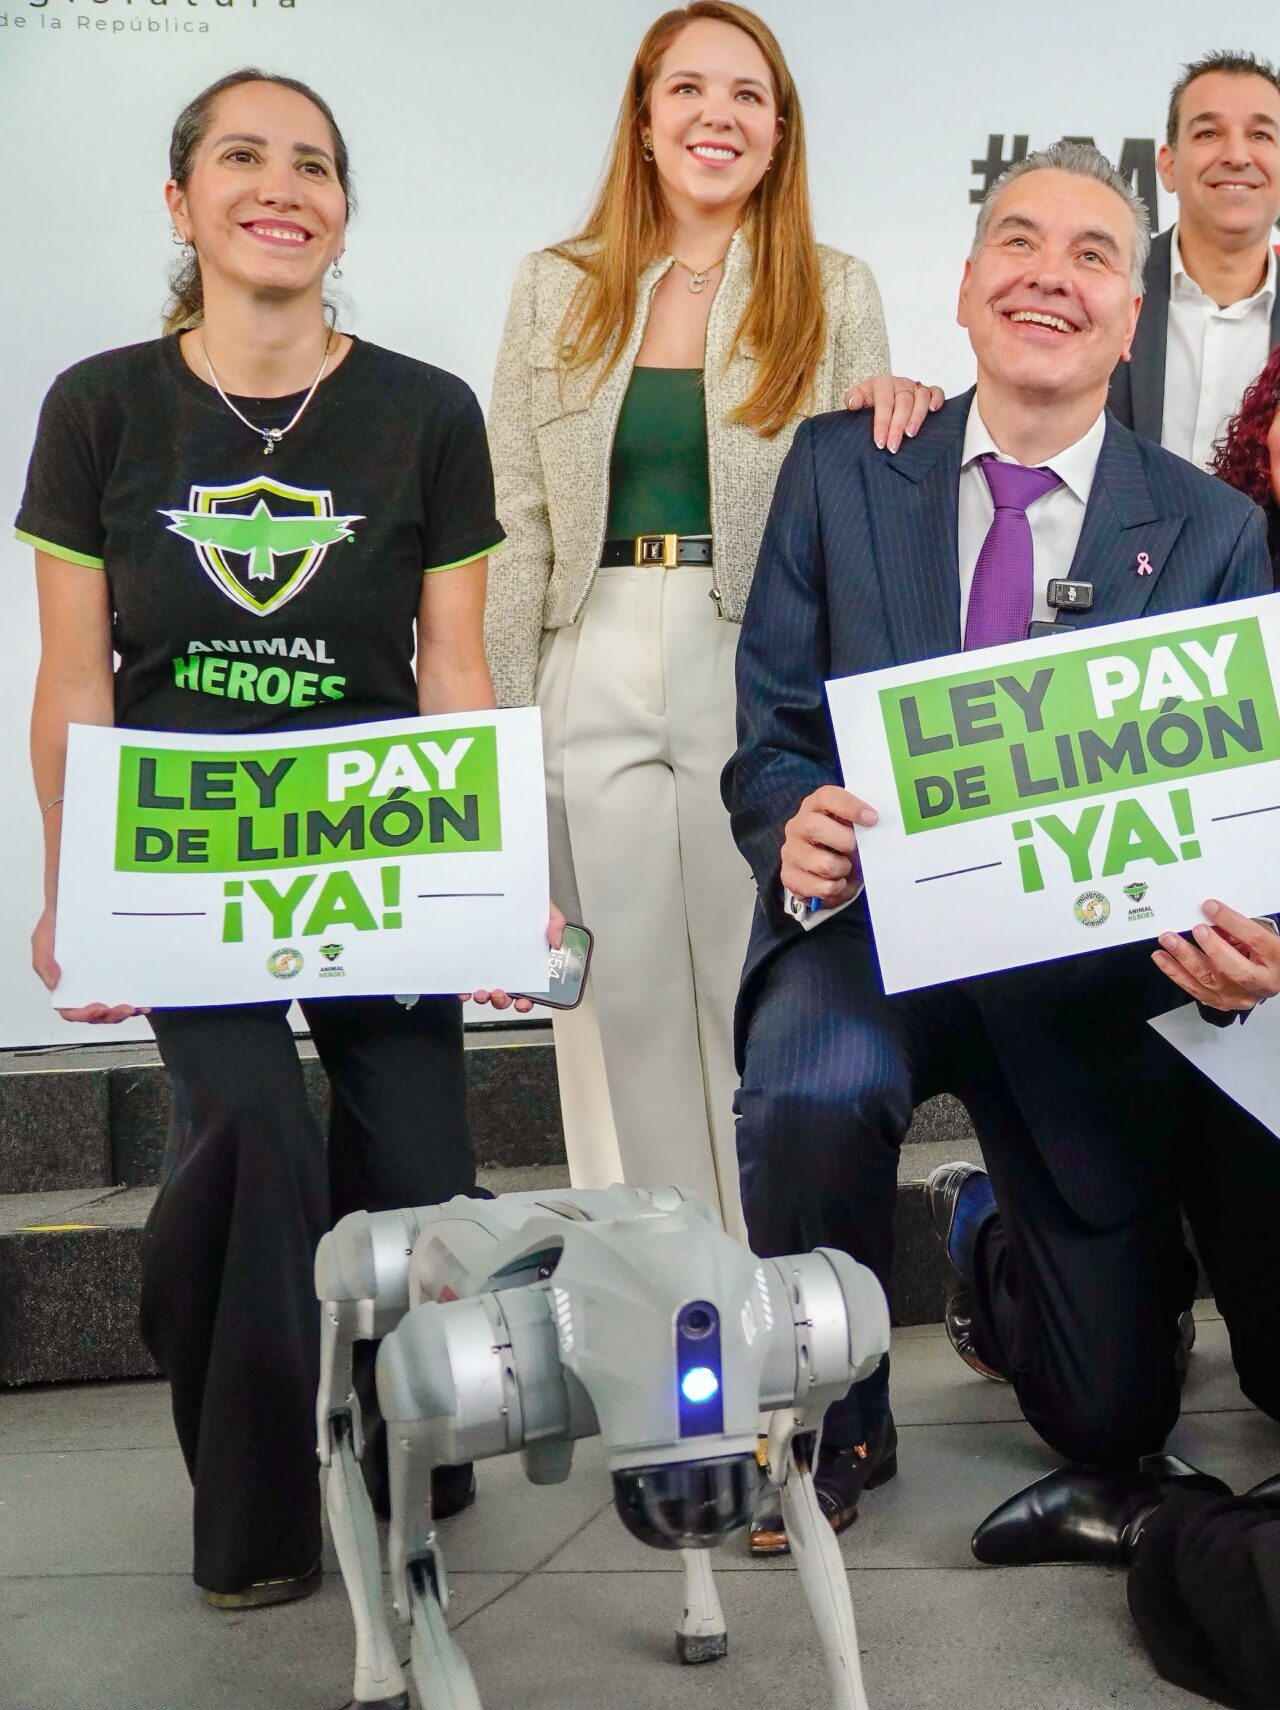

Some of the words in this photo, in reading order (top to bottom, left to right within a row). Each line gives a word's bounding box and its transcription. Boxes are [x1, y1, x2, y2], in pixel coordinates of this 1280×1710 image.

[0, 12, 26, 28] de
[41, 13, 62, 29] la
[77, 16, 209, 34] República
[172, 655, 346, 708] HEROES
[187, 637, 335, 664] ANIMAL
[899, 667, 1055, 758] LEY
[1086, 632, 1238, 720] PAY
[137, 757, 297, 811] LEY
[327, 737, 475, 803] PAY
[914, 765, 991, 820] DE
[1010, 696, 1264, 798] LIMÓN
[135, 826, 210, 863] DE
[237, 786, 480, 862] LIMÓN
[1011, 788, 1203, 894] ¡YA!
[222, 865, 403, 943] ¡YA!
[1127, 911, 1155, 922] HEROES
[1128, 905, 1152, 915] ANIMAL
